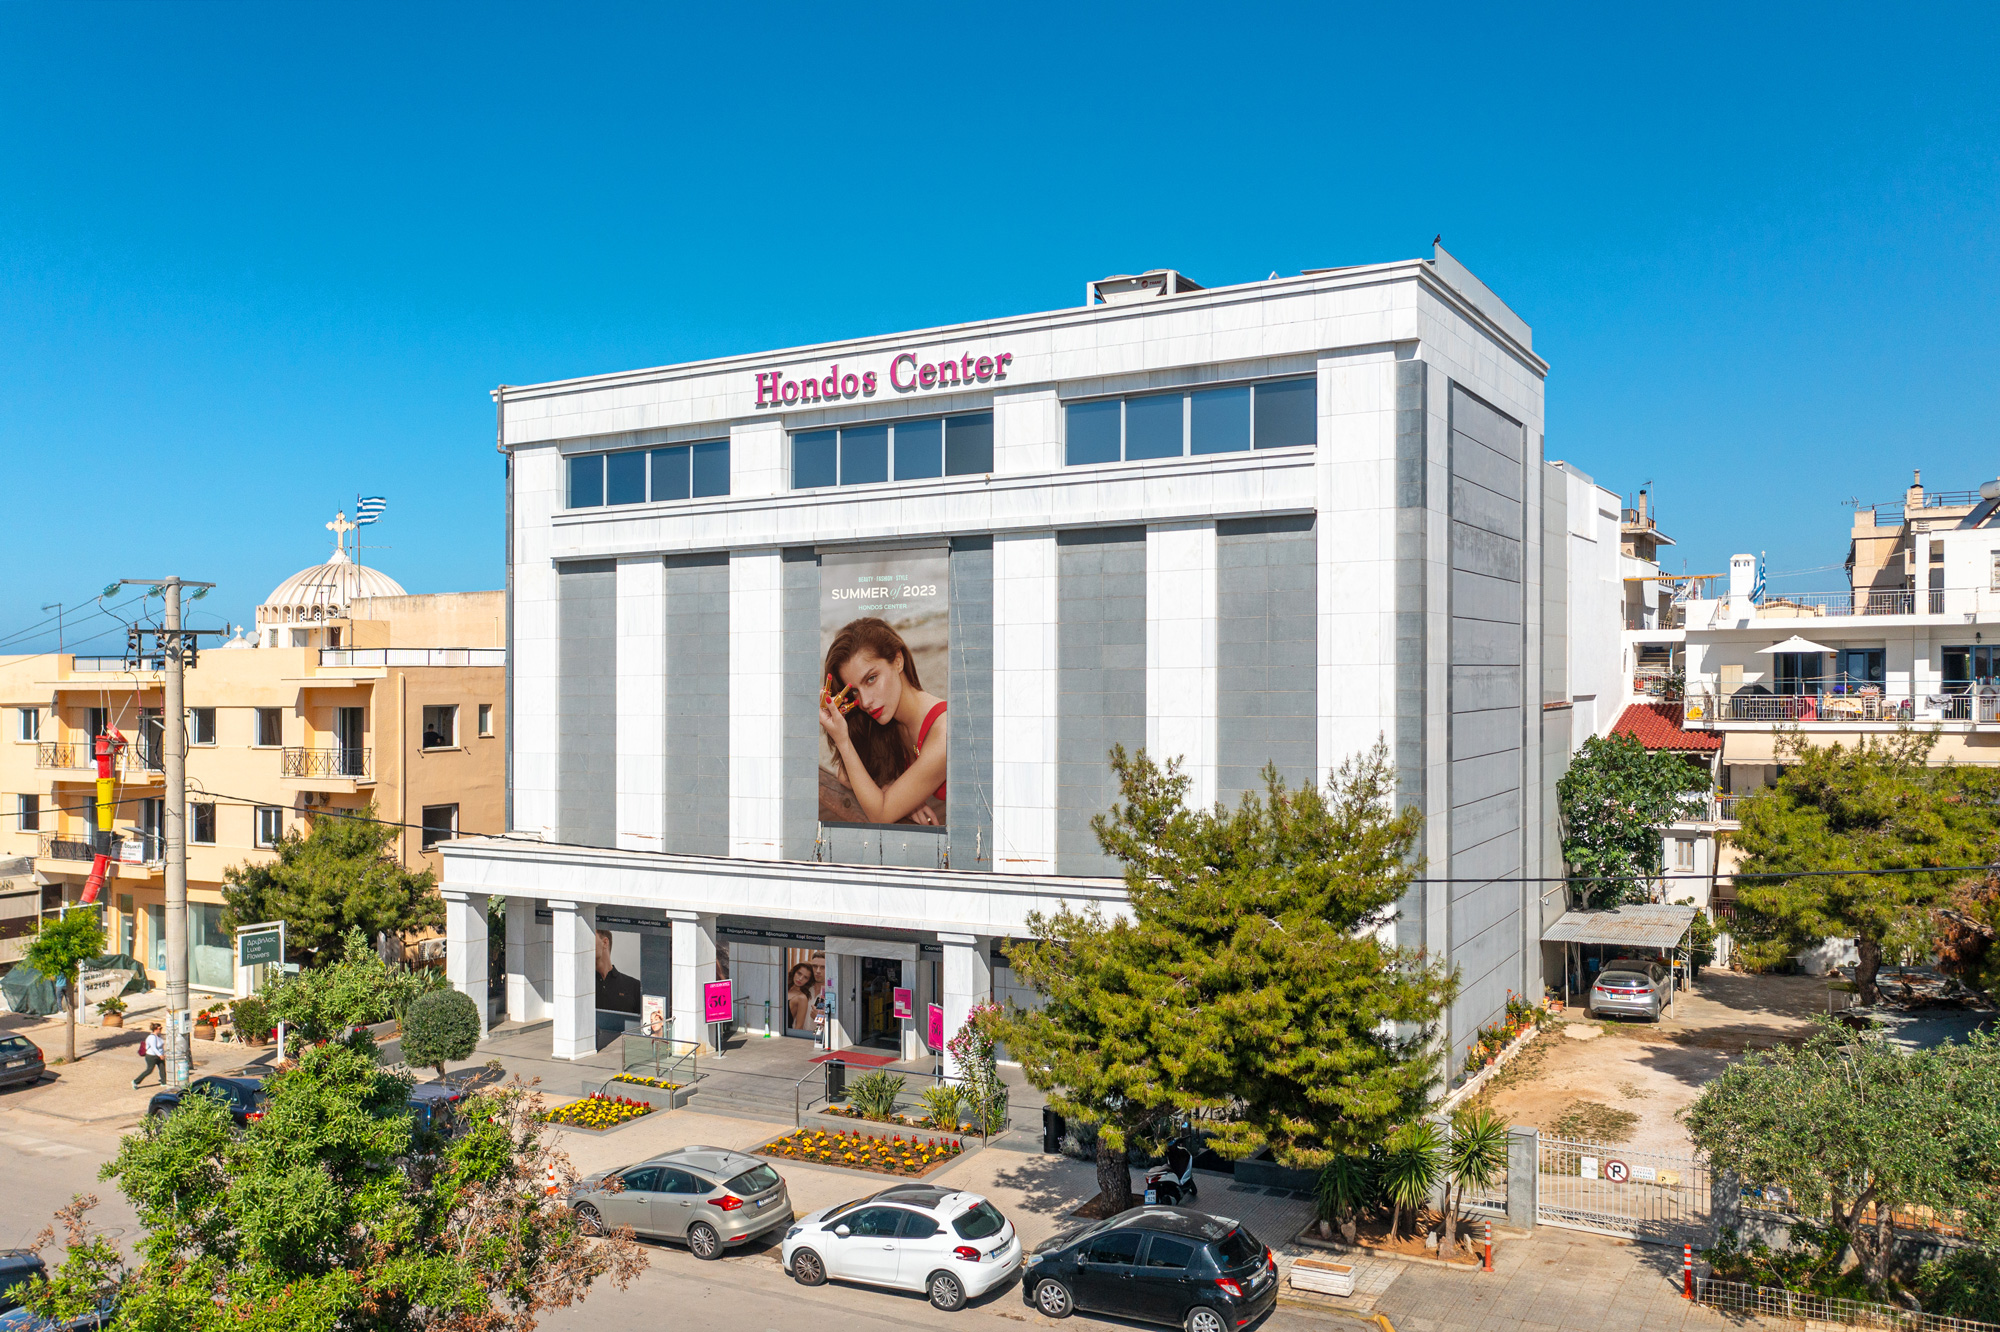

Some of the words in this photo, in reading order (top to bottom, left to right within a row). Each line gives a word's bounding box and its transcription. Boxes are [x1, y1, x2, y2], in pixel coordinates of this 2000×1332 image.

[754, 364, 877, 405] Hondos
[890, 351, 1013, 389] Center
[831, 586, 889, 599] SUMMER
[889, 583, 905, 600] of
[903, 585, 937, 597] 2023
[246, 952, 270, 960] Flowers
